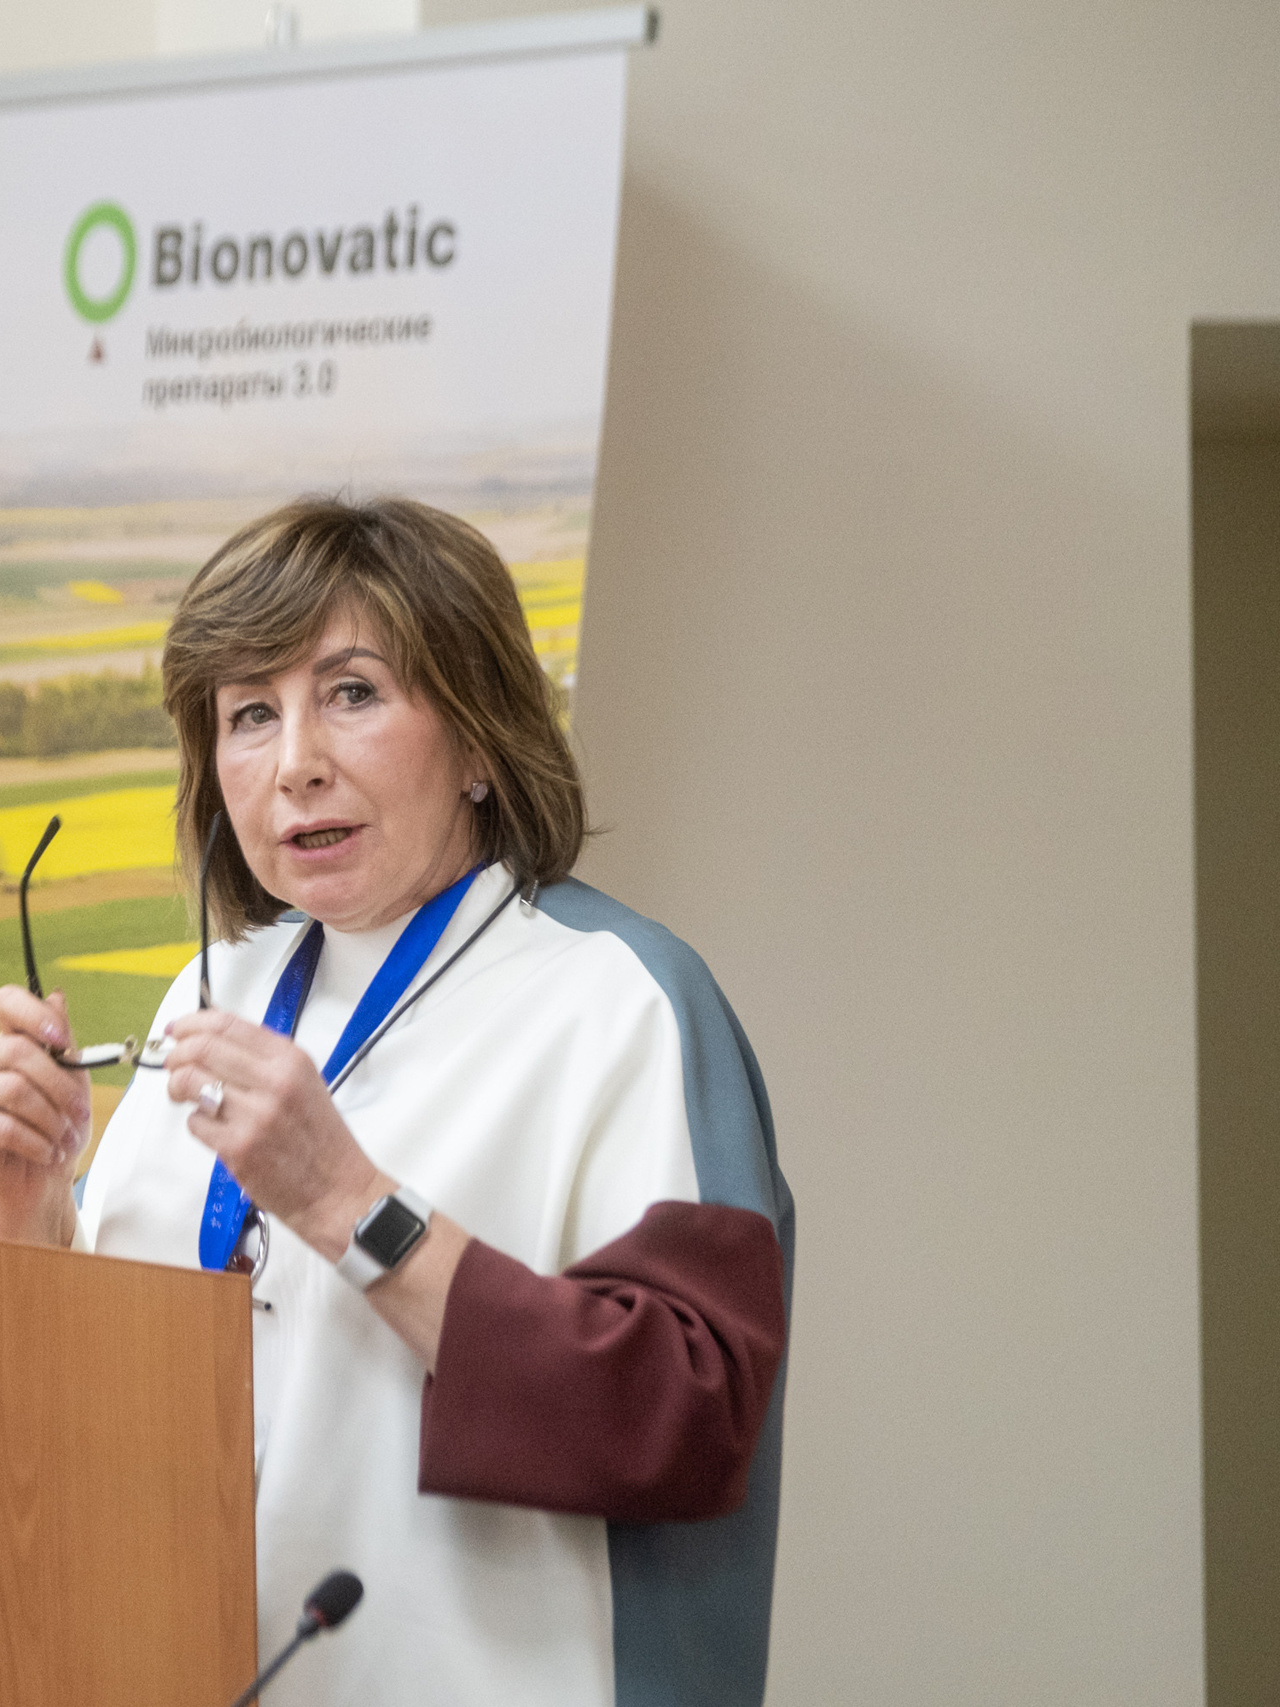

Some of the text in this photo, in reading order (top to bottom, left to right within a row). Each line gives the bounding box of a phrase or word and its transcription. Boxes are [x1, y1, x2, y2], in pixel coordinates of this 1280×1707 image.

[153, 206, 457, 286] Bionovatic
[146, 315, 432, 360] Микробиологические
[143, 360, 336, 408] препараты 3.0
